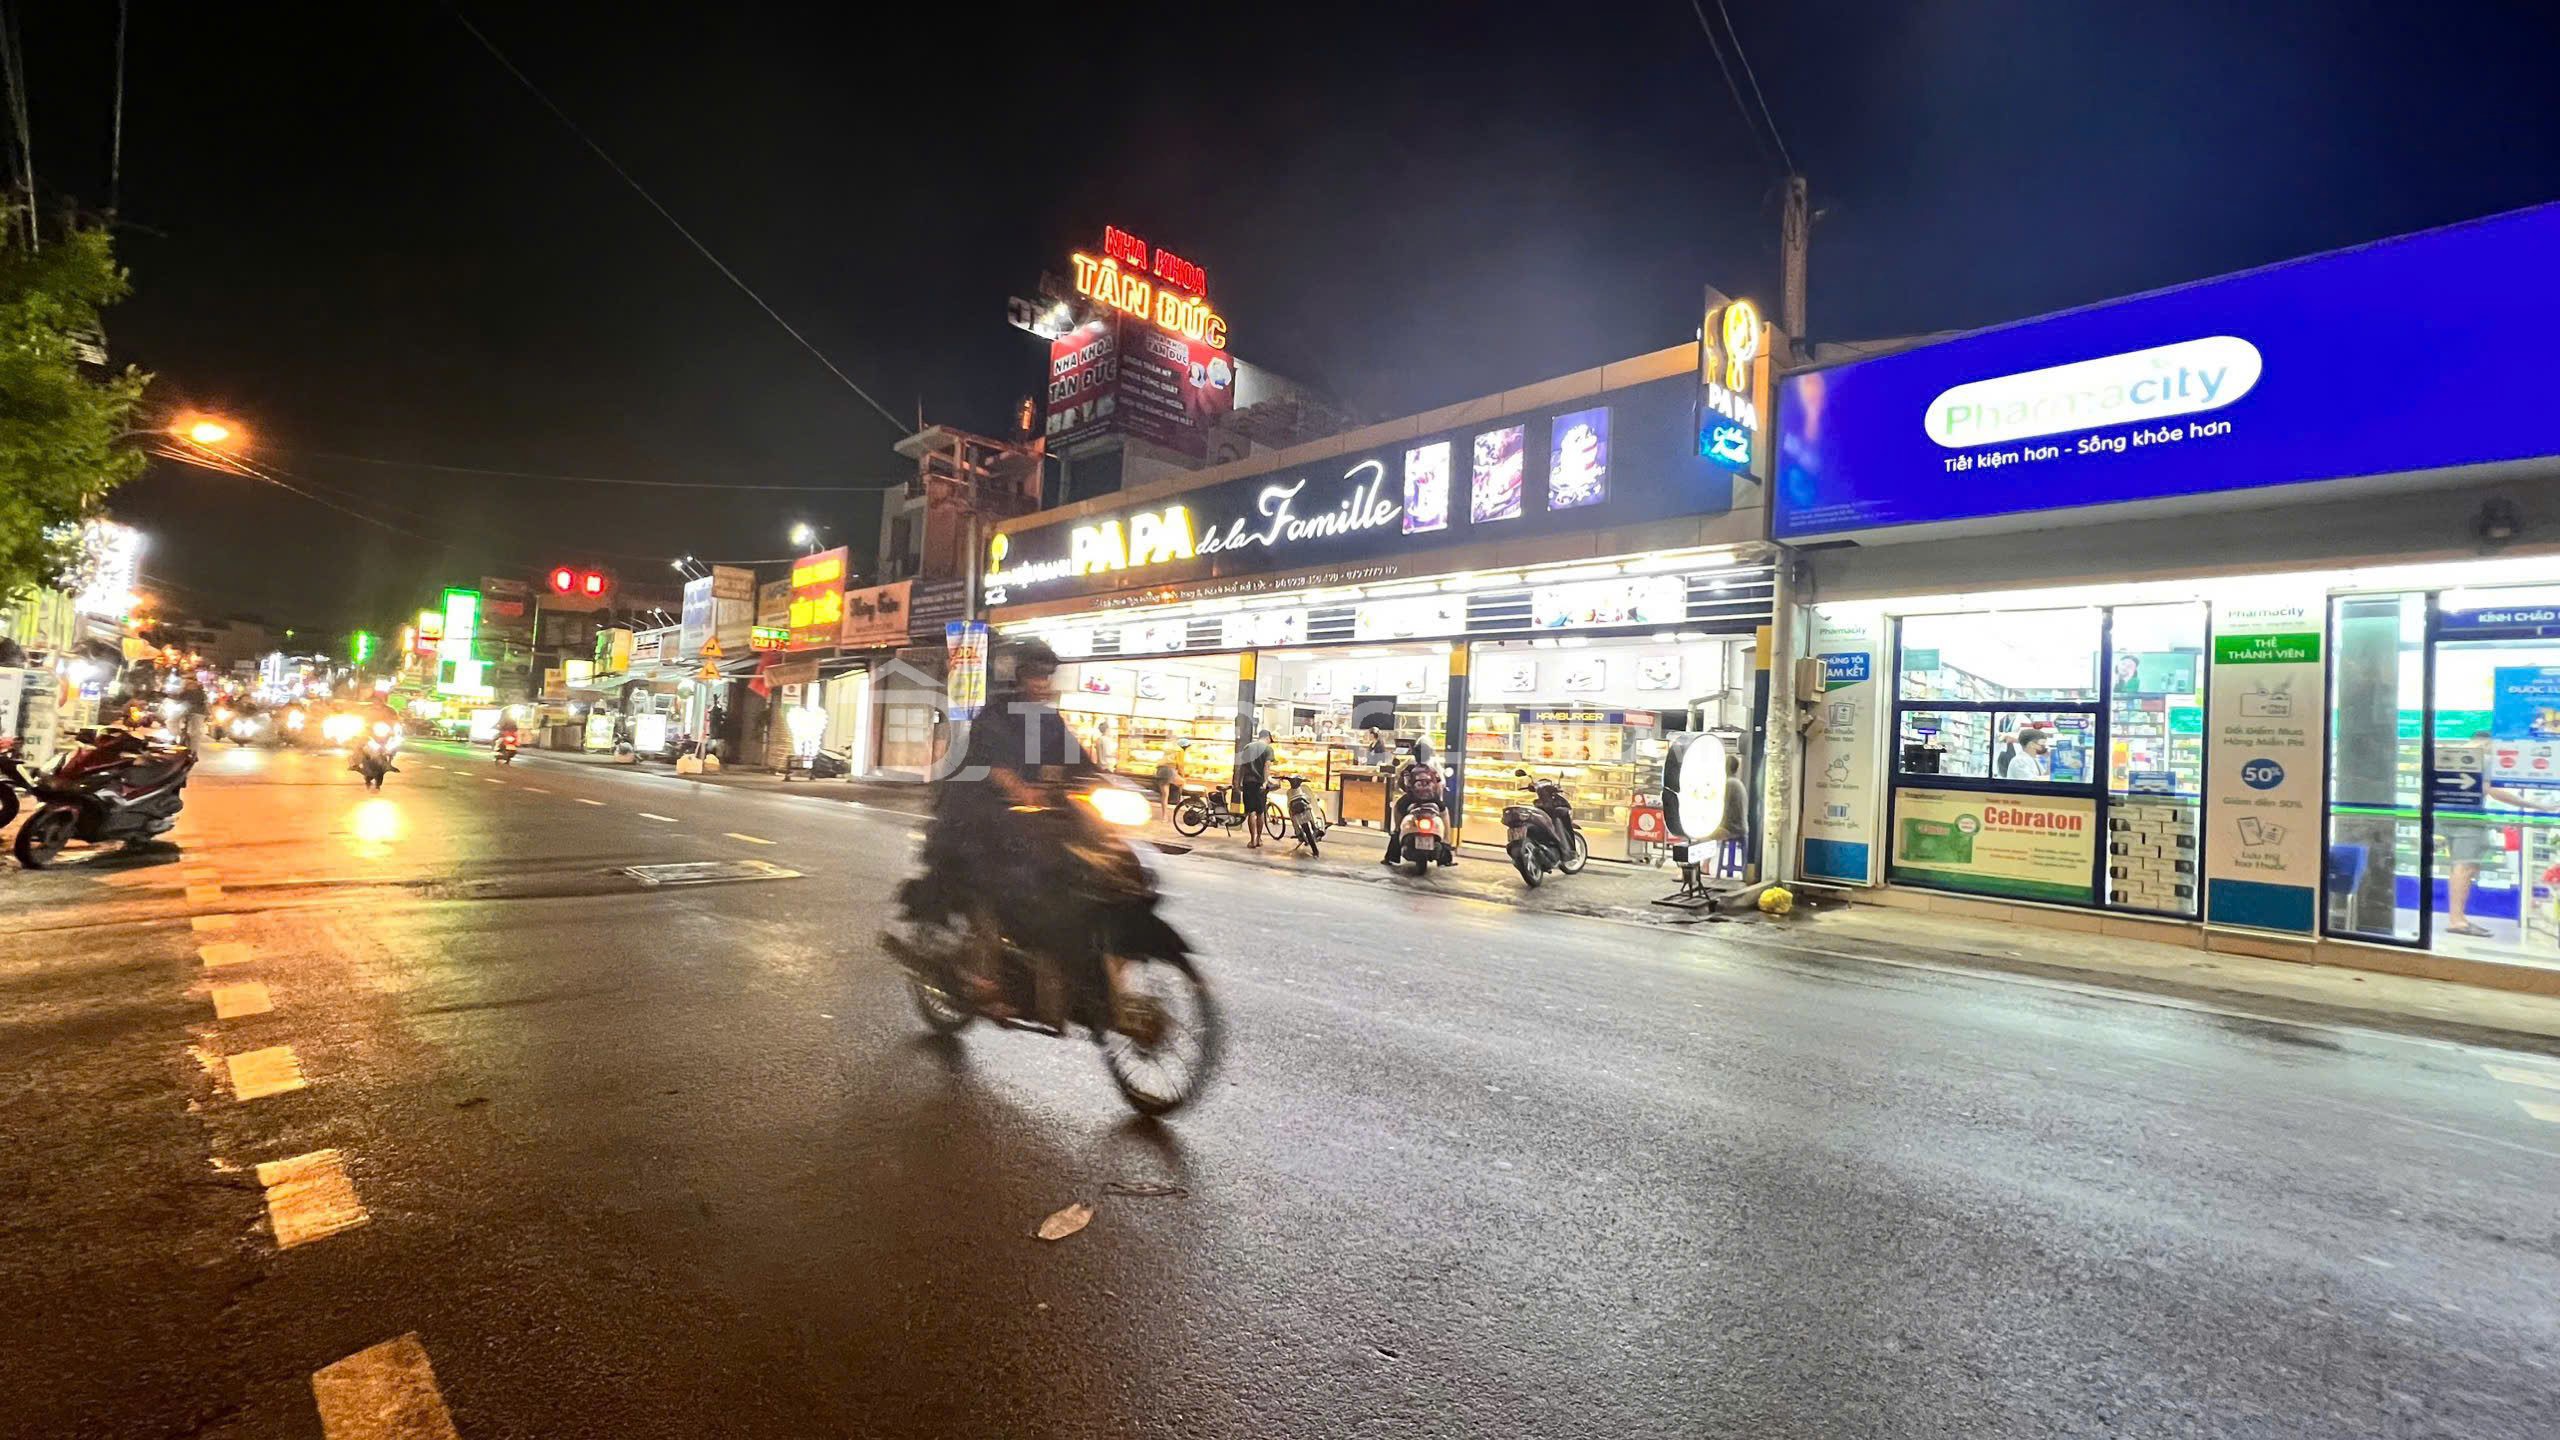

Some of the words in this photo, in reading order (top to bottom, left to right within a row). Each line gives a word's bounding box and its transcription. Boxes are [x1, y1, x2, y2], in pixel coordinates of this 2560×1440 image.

[1104, 226, 1147, 270] NHA
[1154, 248, 1206, 297] KHOA
[1072, 253, 1150, 320] TÂN
[1156, 289, 1226, 349] ĐỨC
[1054, 352, 1077, 376] NHA
[1049, 374, 1079, 404] TÂN
[1944, 456, 1973, 473] Tiết
[1977, 449, 2020, 469] kiệm
[2024, 444, 2059, 462] hơn
[2078, 434, 2127, 455] Sống
[2132, 426, 2184, 447] khỏe
[2189, 420, 2232, 439] hơn
[1258, 460, 1402, 546] Famille
[2514, 609, 2555, 622] CHÀO
[2229, 648, 2273, 660] THÀNH
[2275, 647, 2305, 658] VIÊN
[2255, 635, 2278, 649] THẺ
[1826, 668, 1844, 677] AM
[1536, 711, 1604, 722] HAMBURGER
[1984, 806, 2083, 832] Cebraton
